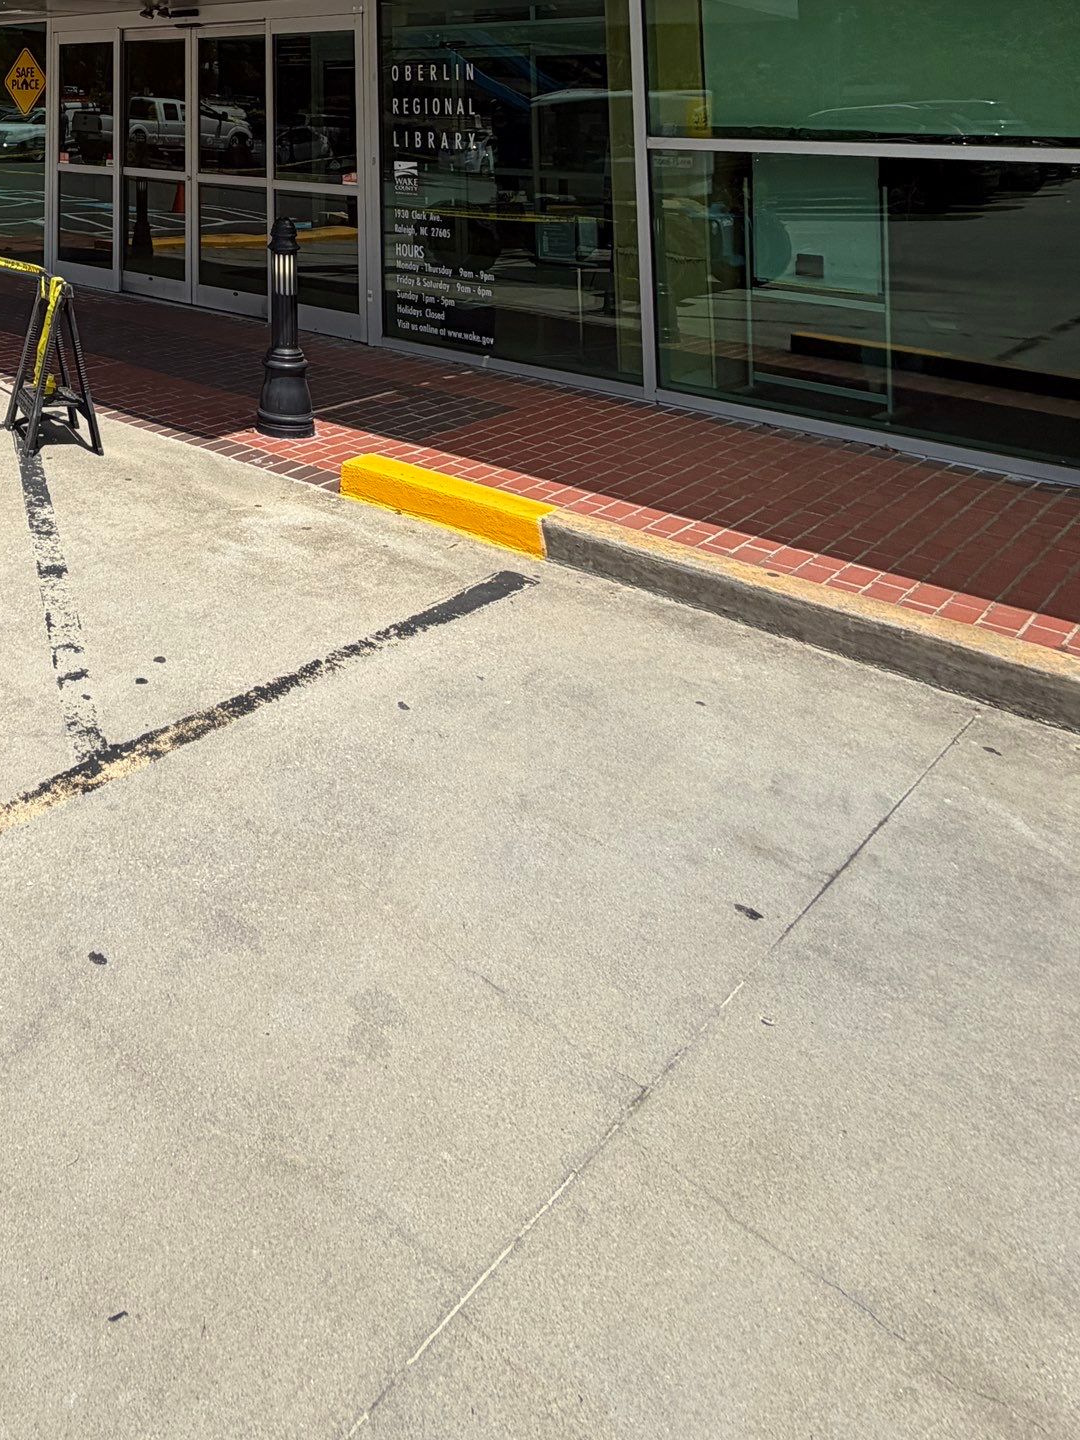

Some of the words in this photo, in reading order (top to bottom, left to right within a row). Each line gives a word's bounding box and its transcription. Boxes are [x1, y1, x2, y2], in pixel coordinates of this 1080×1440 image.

[16, 67, 35, 78] SAFE
[391, 63, 475, 82] OBERLIN
[11, 79, 40, 90] PLACE
[392, 97, 476, 115] REGIONAL
[393, 131, 476, 150] LIBRARY
[395, 177, 418, 186] WAKE
[394, 208, 409, 219] 1930
[411, 210, 427, 220] Clark
[394, 223, 418, 237] Raleigh,
[420, 226, 428, 236] NC
[431, 227, 451, 239] 27605
[395, 243, 425, 259] HOURS
[396, 260, 419, 272] Monday
[424, 263, 453, 277] Thursday
[459, 267, 474, 279] 9am
[480, 270, 495, 282] 9pm
[396, 274, 415, 287] Friday
[422, 278, 450, 292] Saturday
[456, 282, 472, 294] 9am
[477, 286, 493, 298] 6pm
[397, 289, 419, 303] Sunday
[421, 292, 436, 304] 1pm
[440, 295, 456, 307] 5pm
[397, 304, 423, 318] Holidays
[425, 308, 446, 320] Closed
[397, 318, 410, 329] Visit
[419, 323, 439, 335] online
[447, 331, 495, 346] www.wake.gov
